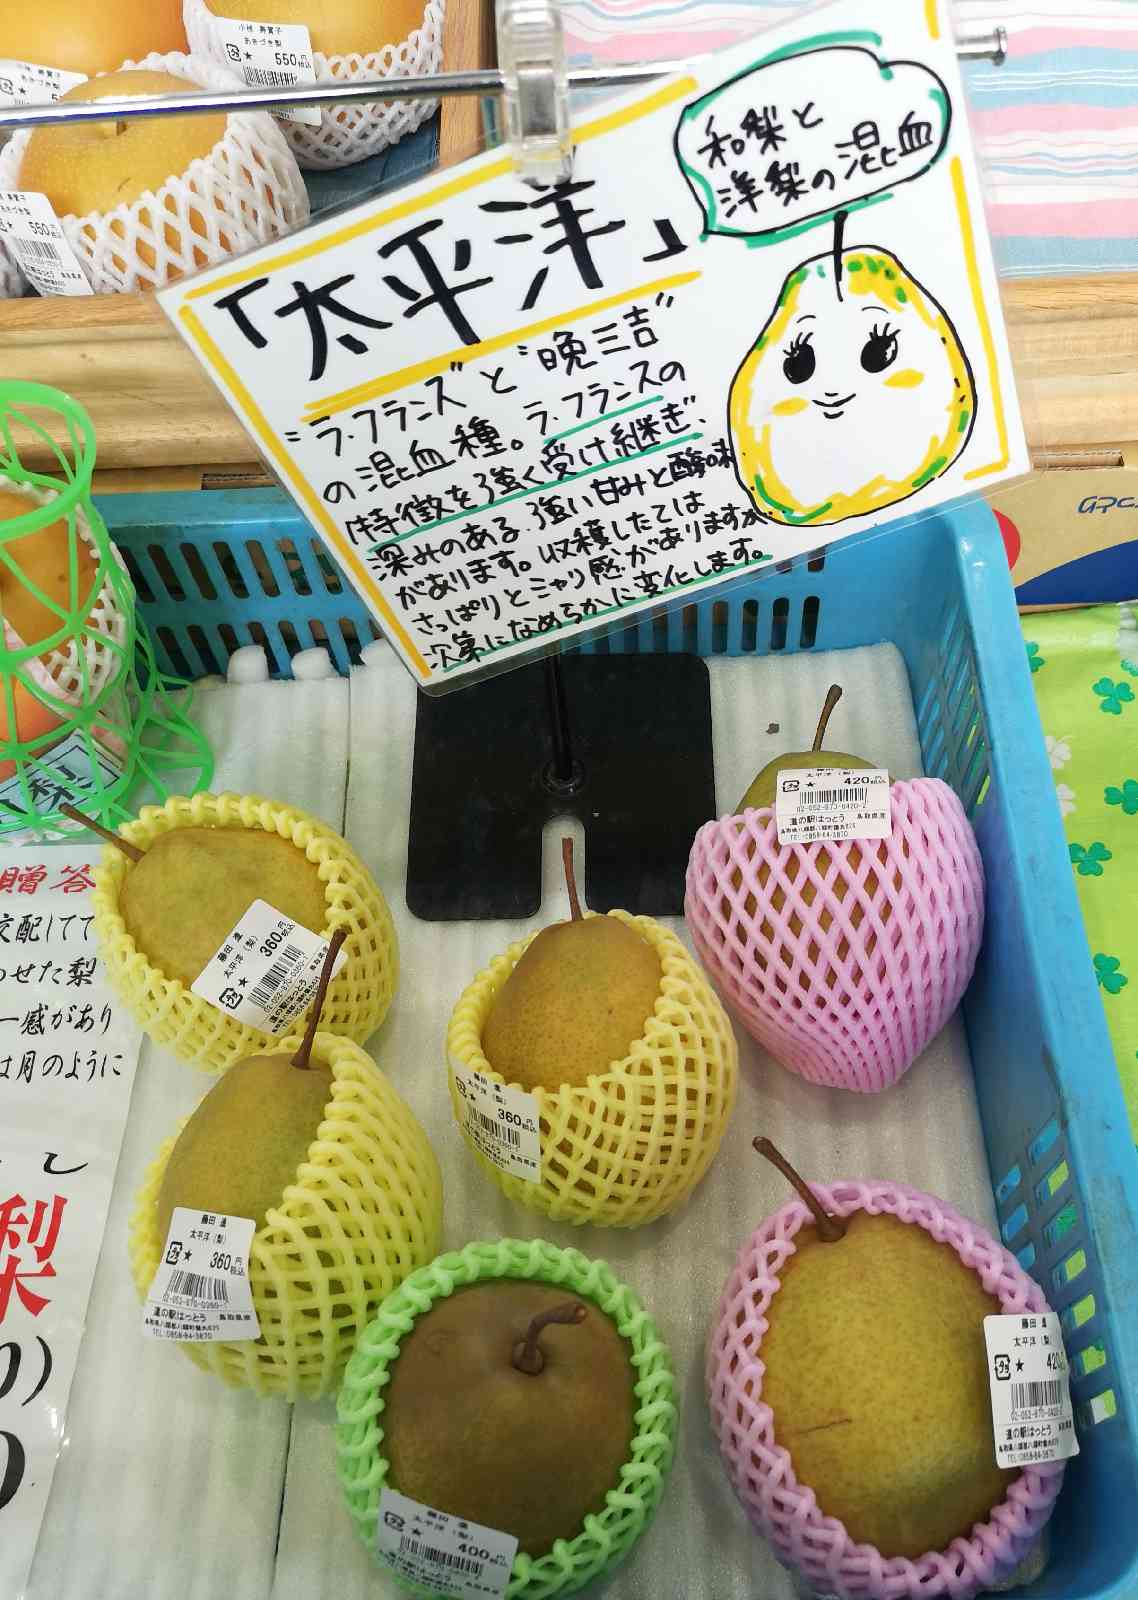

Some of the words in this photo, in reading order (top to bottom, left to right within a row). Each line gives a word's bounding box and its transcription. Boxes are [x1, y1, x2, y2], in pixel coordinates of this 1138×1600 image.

[275, 52, 297, 66] 550
[697, 102, 823, 169] 和梨と
[716, 111, 933, 218] 洋梨の混血
[28, 221, 50, 236] 550
[213, 180, 688, 381] 「太平洋」
[844, 776, 869, 785] 420
[259, 931, 283, 958] 360
[497, 1108, 522, 1127] 360
[209, 1252, 232, 1271] 360
[458, 1543, 490, 1560] 400
